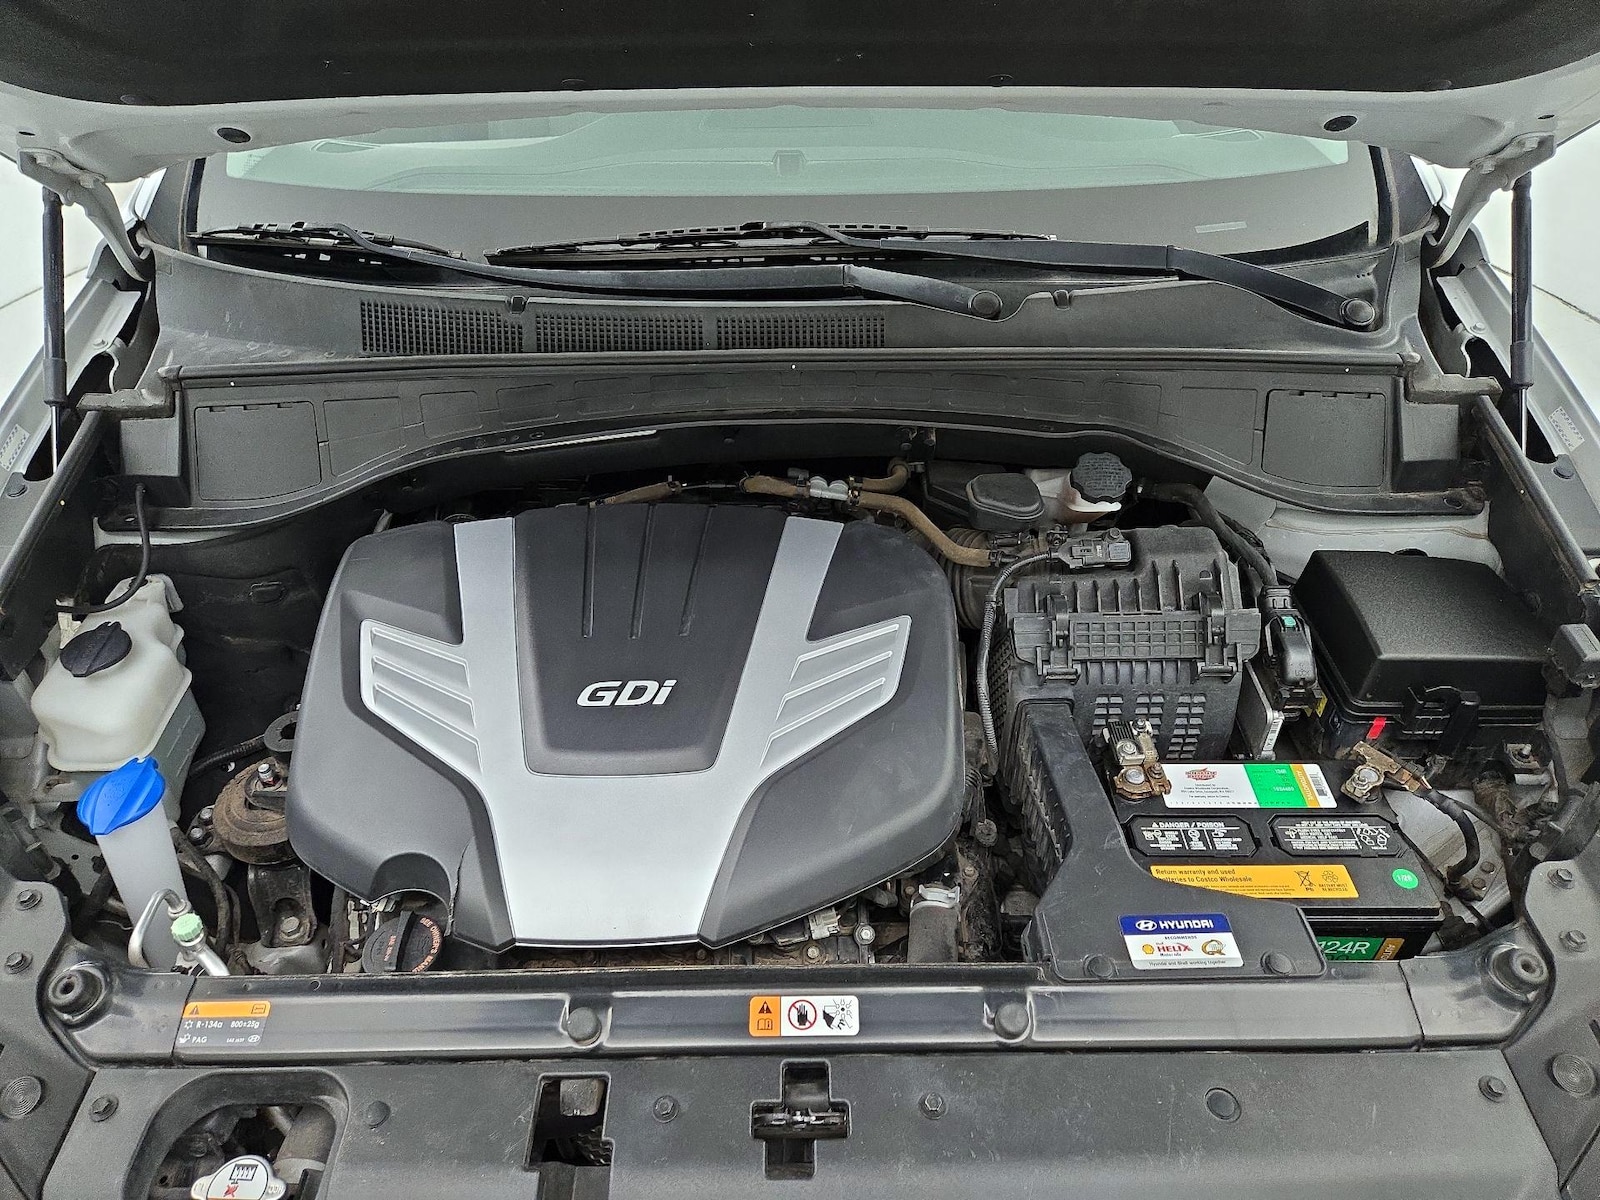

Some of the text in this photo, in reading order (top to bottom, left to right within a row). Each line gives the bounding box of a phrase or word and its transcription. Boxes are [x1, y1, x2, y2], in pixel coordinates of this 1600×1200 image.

[577, 679, 678, 707] GDi
[1159, 919, 1214, 930] HYUNDAI
[1157, 942, 1193, 953] HELIX
[191, 1036, 208, 1044] PAG
